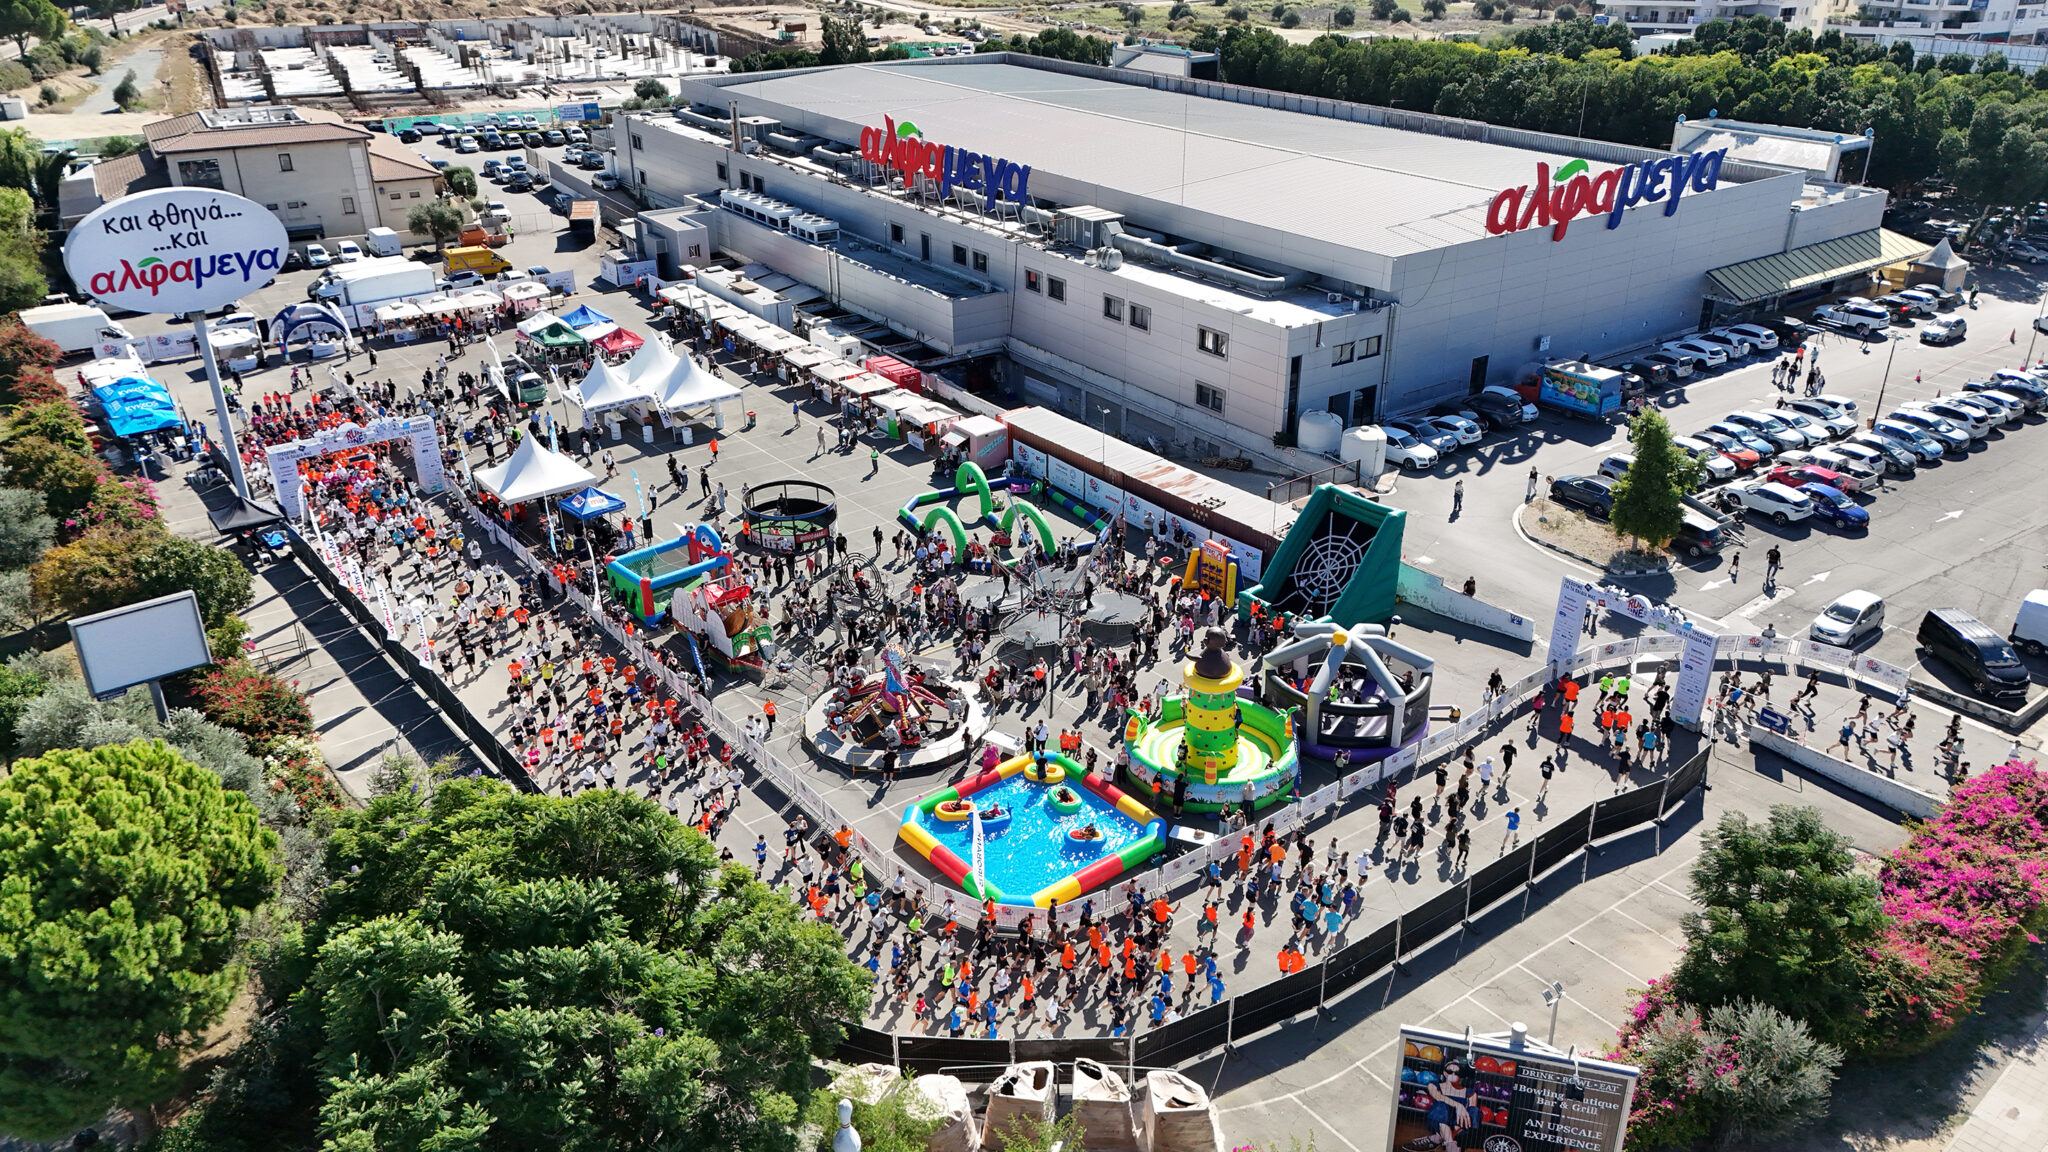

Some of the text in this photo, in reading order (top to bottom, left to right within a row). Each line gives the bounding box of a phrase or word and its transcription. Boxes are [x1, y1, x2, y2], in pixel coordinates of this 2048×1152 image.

[860, 113, 1031, 212] αλφαμεγα
[1485, 148, 1729, 242] αλφαμεγα
[102, 198, 243, 235] και φθηνά...
[153, 231, 208, 252] ...και
[90, 247, 280, 297] αλφαμεγα
[1522, 1069, 1554, 1080] DRINK
[1599, 1084, 1620, 1092] EAT
[1519, 1084, 1619, 1110] Bowling utique
[1536, 1097, 1598, 1115] Bar & Grill
[1523, 1130, 1601, 1152] EXPERIENCE
[1525, 1118, 1603, 1140] AN UPSCALE
